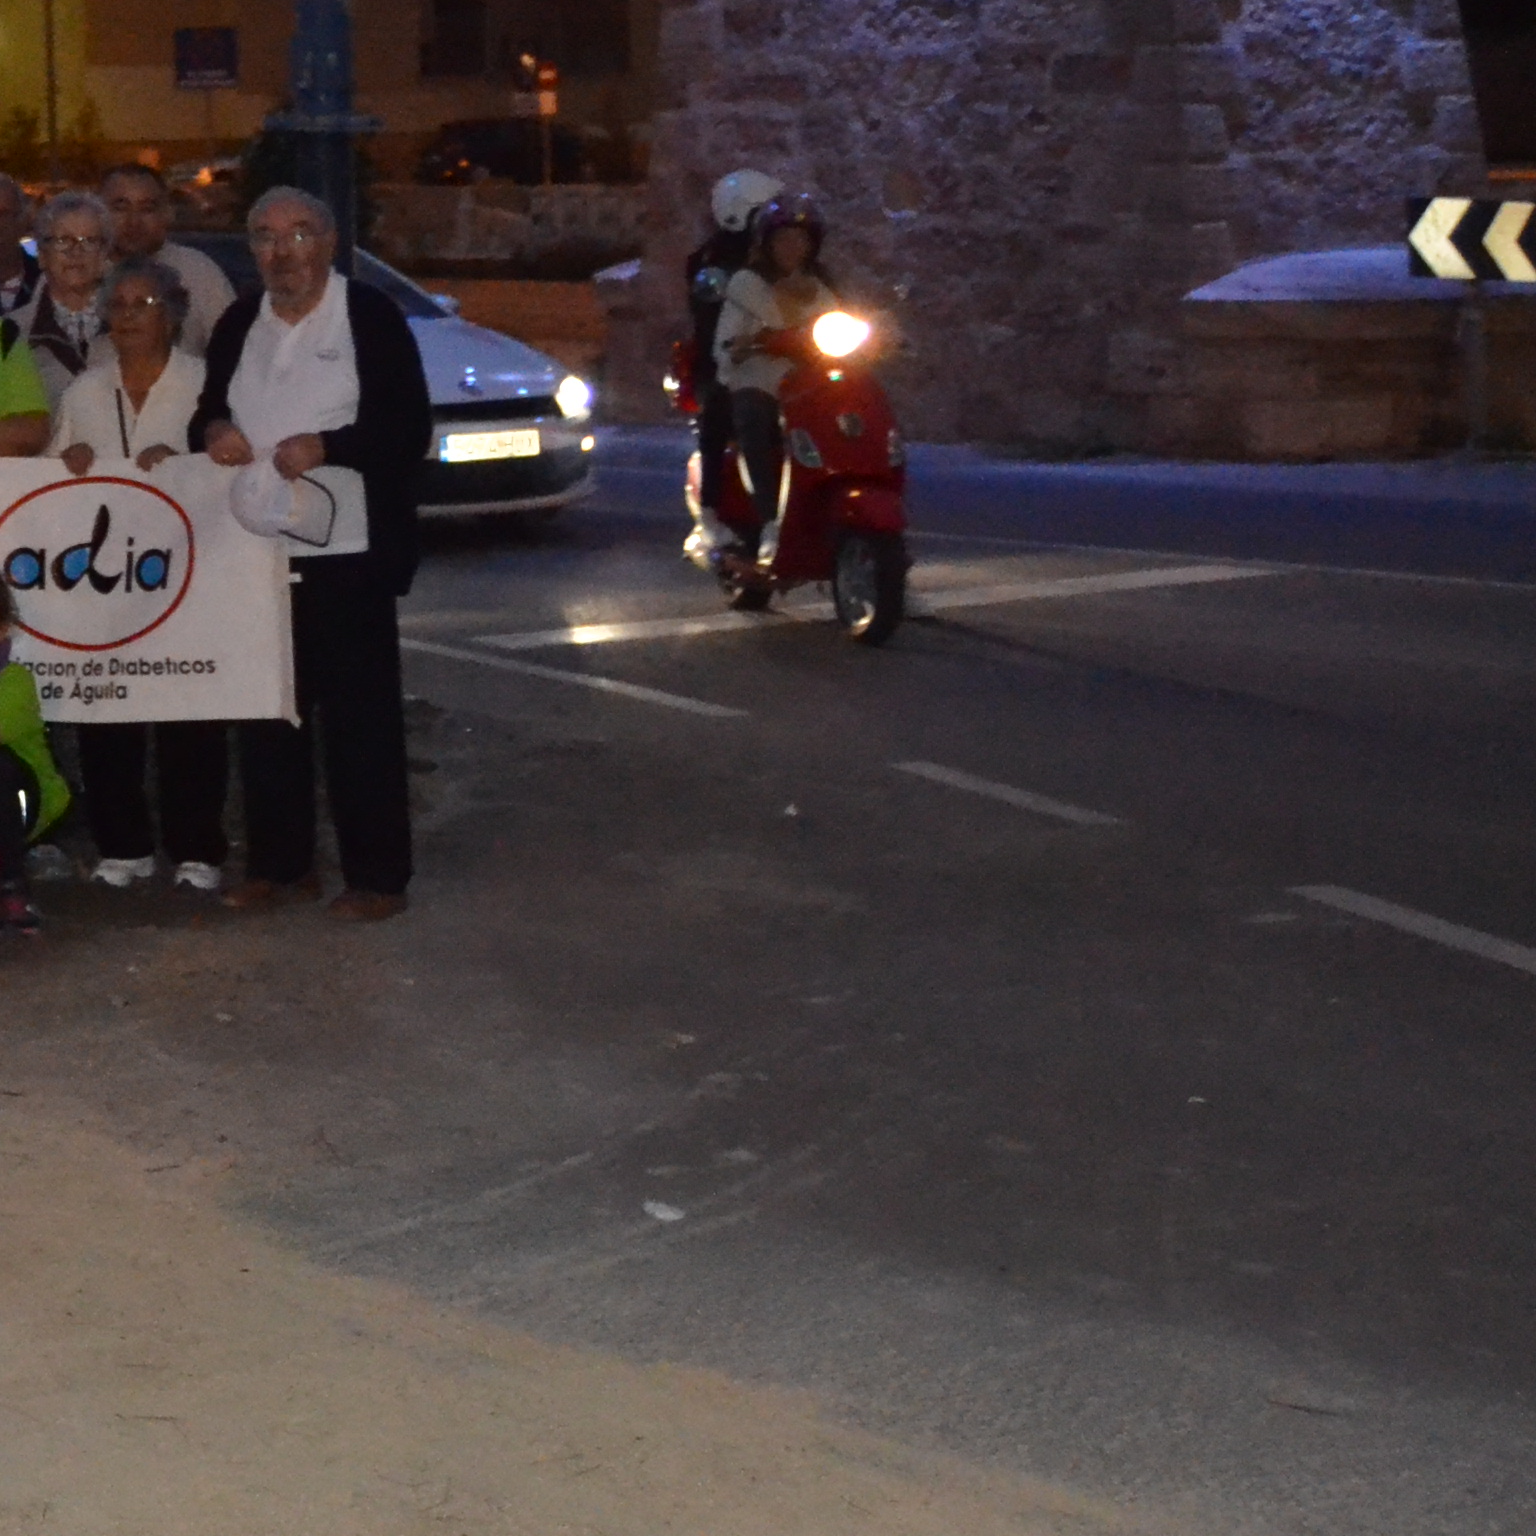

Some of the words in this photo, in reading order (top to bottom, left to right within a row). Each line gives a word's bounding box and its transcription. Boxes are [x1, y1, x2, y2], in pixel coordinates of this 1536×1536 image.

[4, 504, 172, 594] adia
[82, 658, 104, 676] de
[41, 682, 64, 700] de
